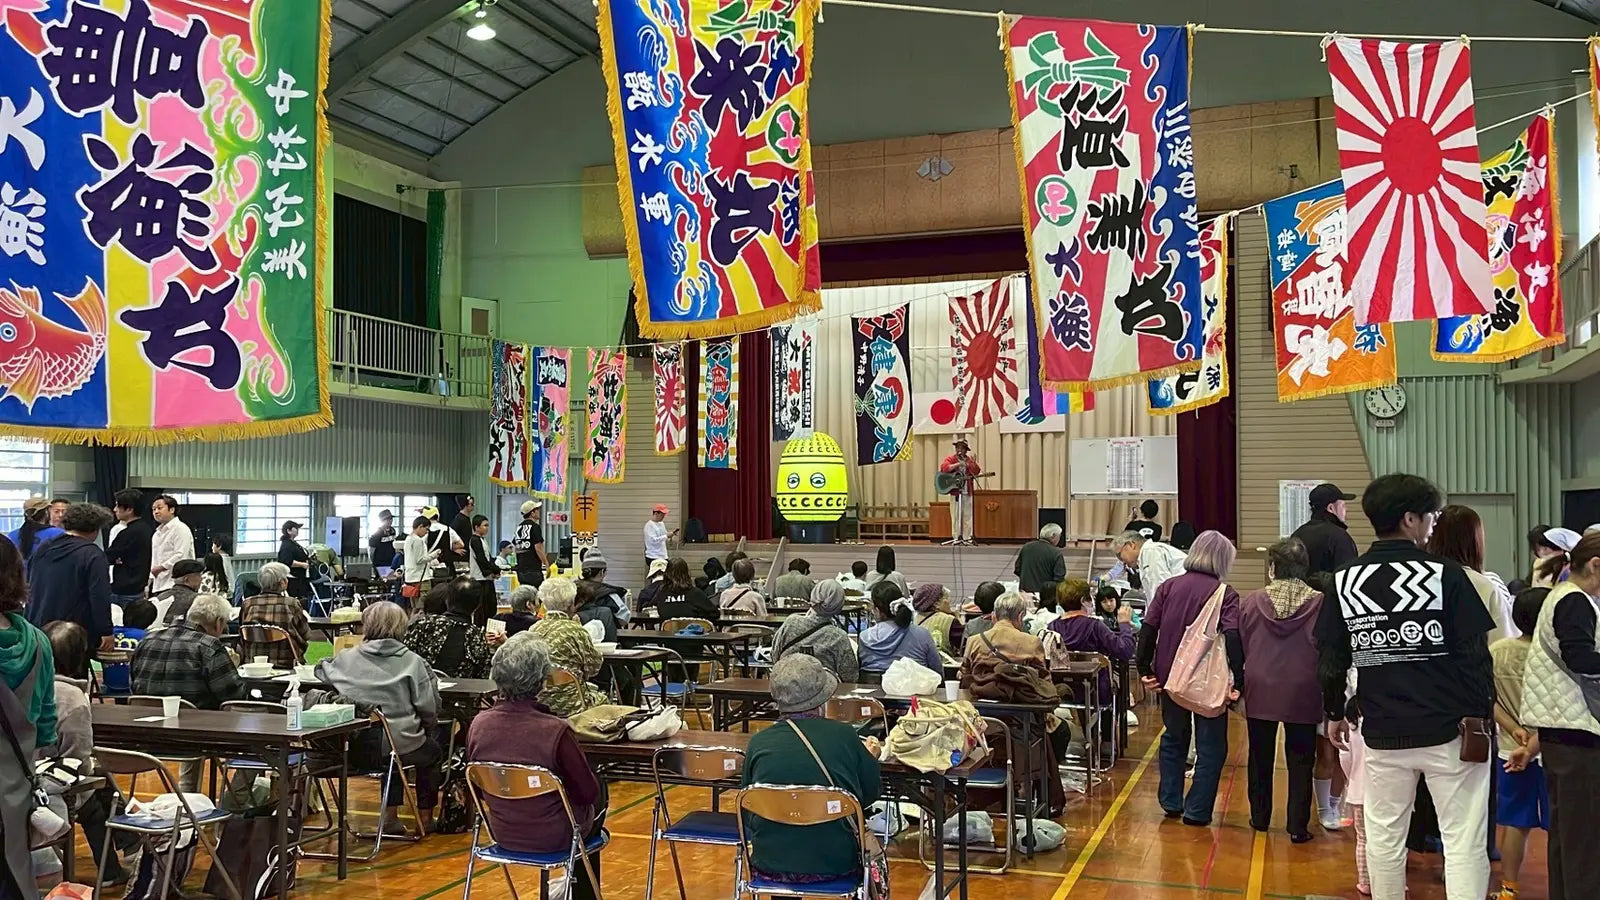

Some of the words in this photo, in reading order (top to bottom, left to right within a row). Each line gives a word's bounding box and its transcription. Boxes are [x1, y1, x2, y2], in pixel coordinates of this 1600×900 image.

[624, 70, 672, 226] 甑水軍
[709, 363, 730, 461] 健康丸
[870, 336, 898, 462] 健康丸
